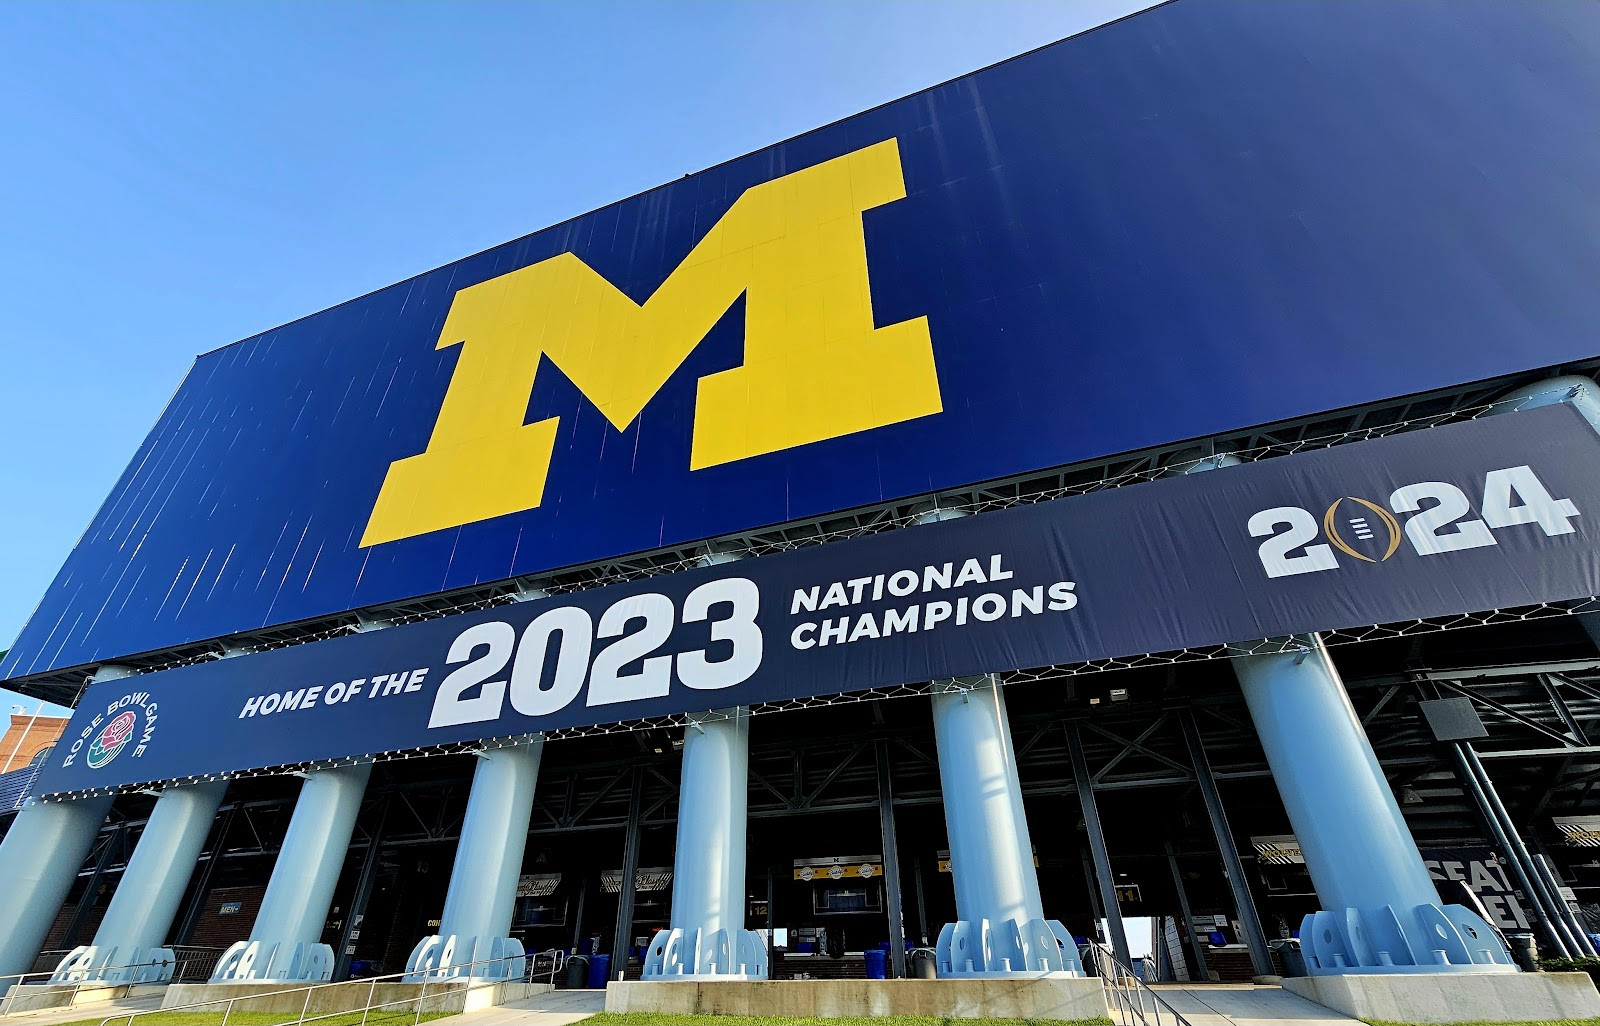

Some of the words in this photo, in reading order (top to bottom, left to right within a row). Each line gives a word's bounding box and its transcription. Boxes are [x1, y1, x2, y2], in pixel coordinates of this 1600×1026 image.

[361, 138, 943, 548] M
[790, 553, 1014, 615] NATIONAL
[790, 581, 1078, 650] CHAMPIONS
[238, 685, 324, 719] HOME
[324, 678, 367, 706] OF
[368, 667, 430, 699] THE
[427, 577, 763, 729] 2023
[62, 713, 104, 768] ROSE
[107, 692, 151, 716] BOWL
[132, 702, 158, 758] GAME
[754, 905, 768, 916] 12
